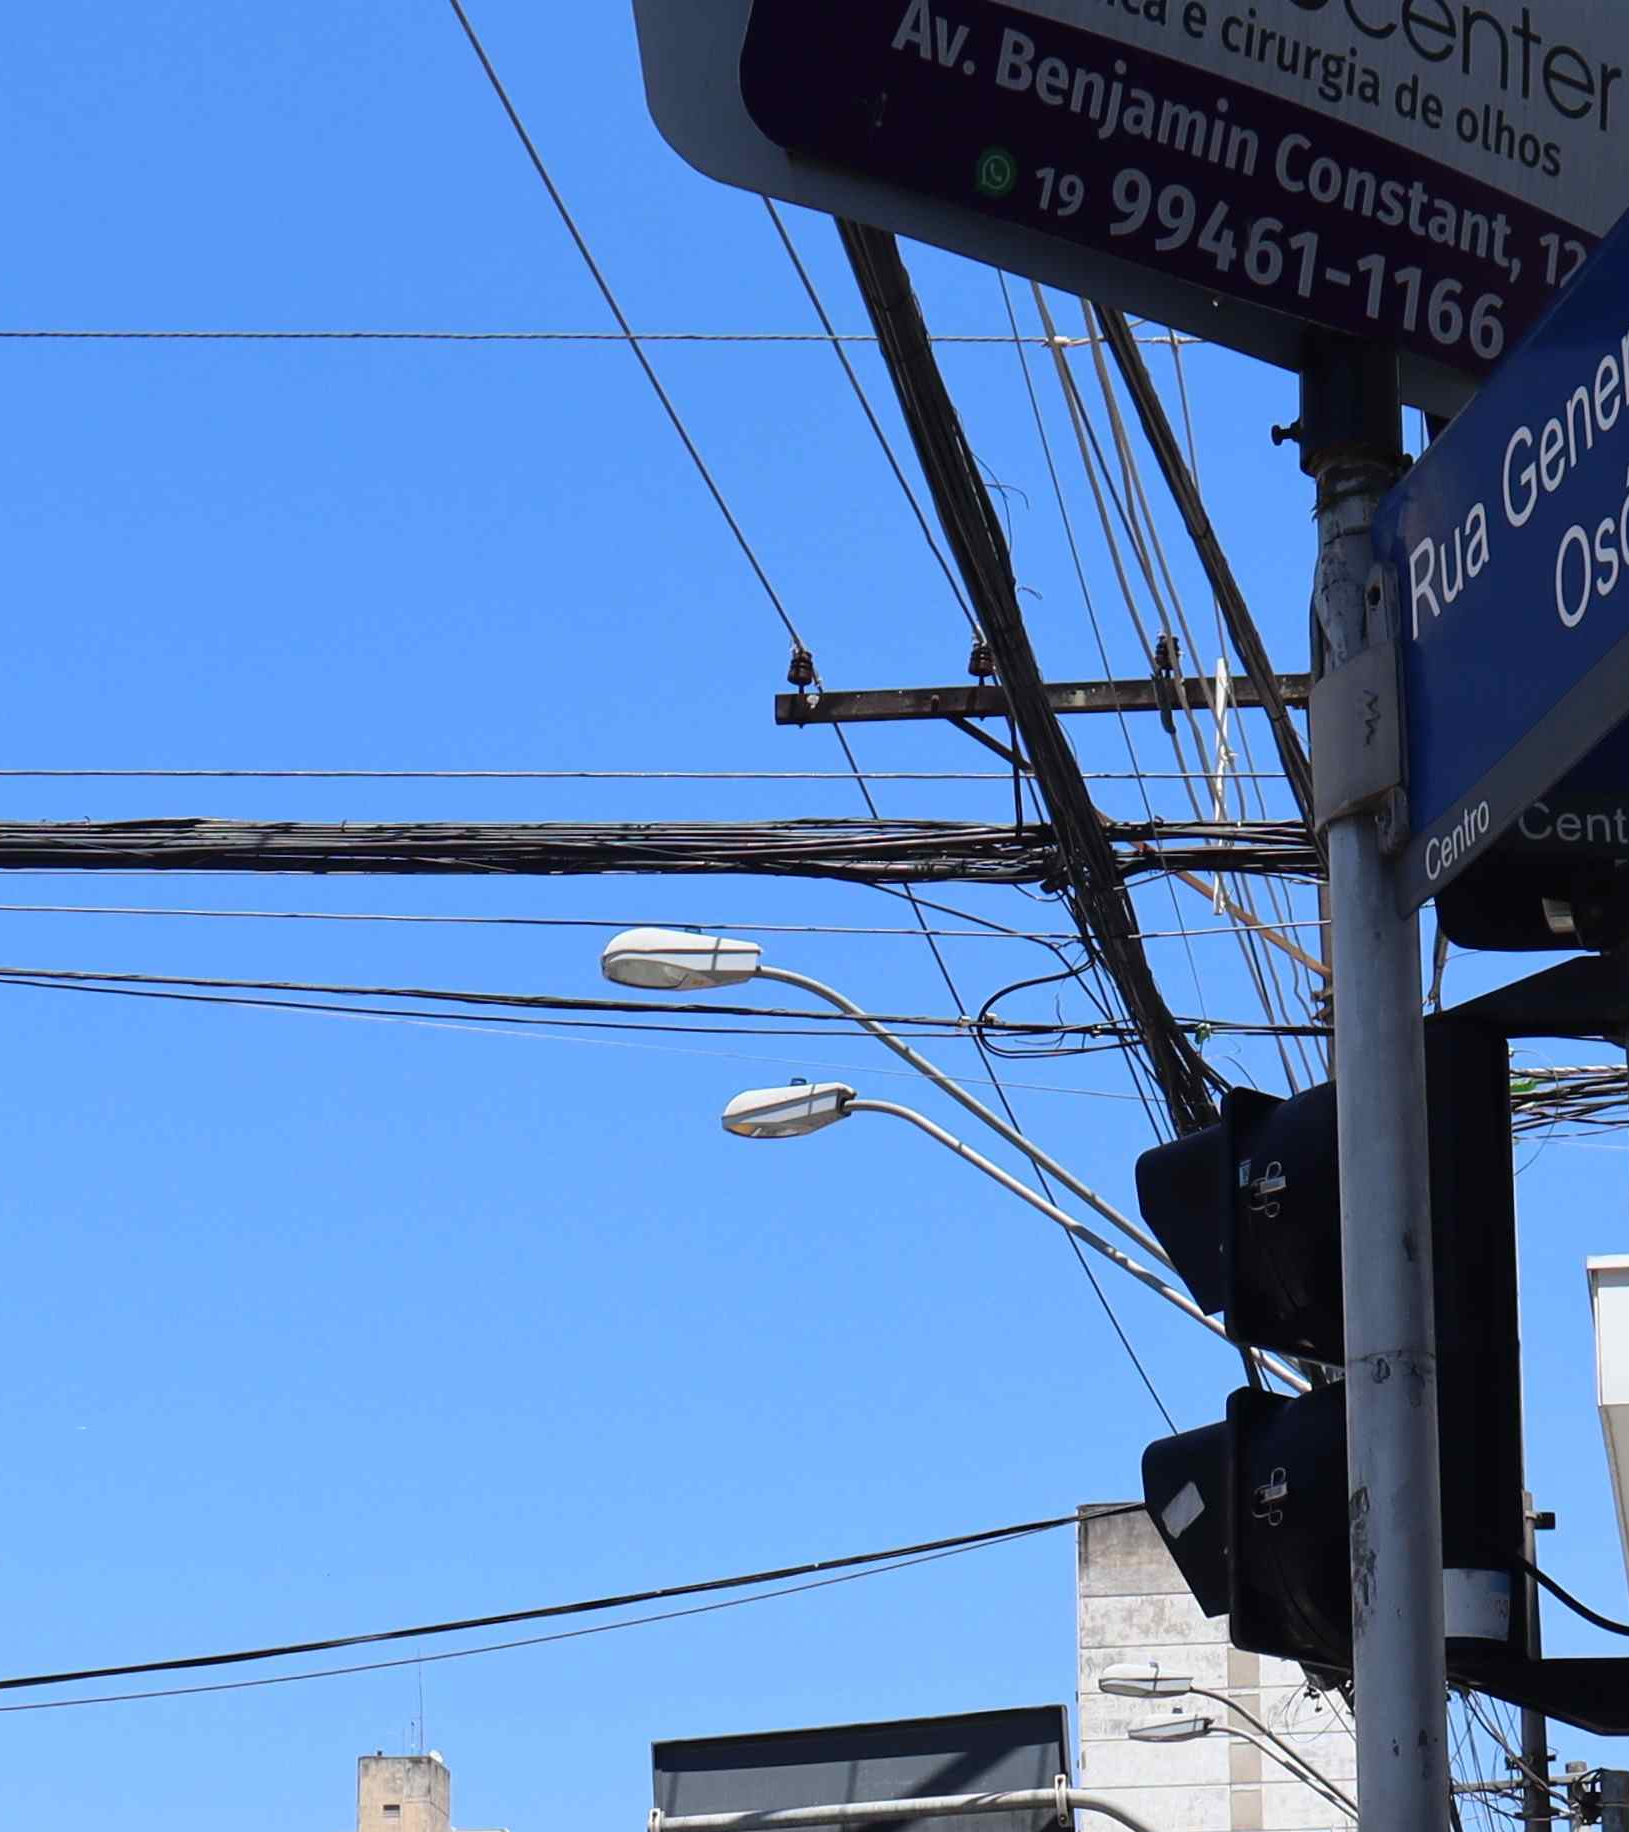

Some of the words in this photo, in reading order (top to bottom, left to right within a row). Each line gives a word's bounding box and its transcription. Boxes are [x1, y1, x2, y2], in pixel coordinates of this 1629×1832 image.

[890, 0, 975, 75] Av.
[995, 28, 1259, 177] Benjamin
[1262, 132, 1521, 284] Constant,
[1221, 8, 1380, 106] cirurgia
[1395, 74, 1443, 129] de
[1456, 104, 1561, 177] olhos
[1034, 166, 1084, 217] 19
[1109, 167, 1505, 360] 99461-1166
[1409, 502, 1490, 641] Rua
[1424, 800, 1490, 880] Centro
